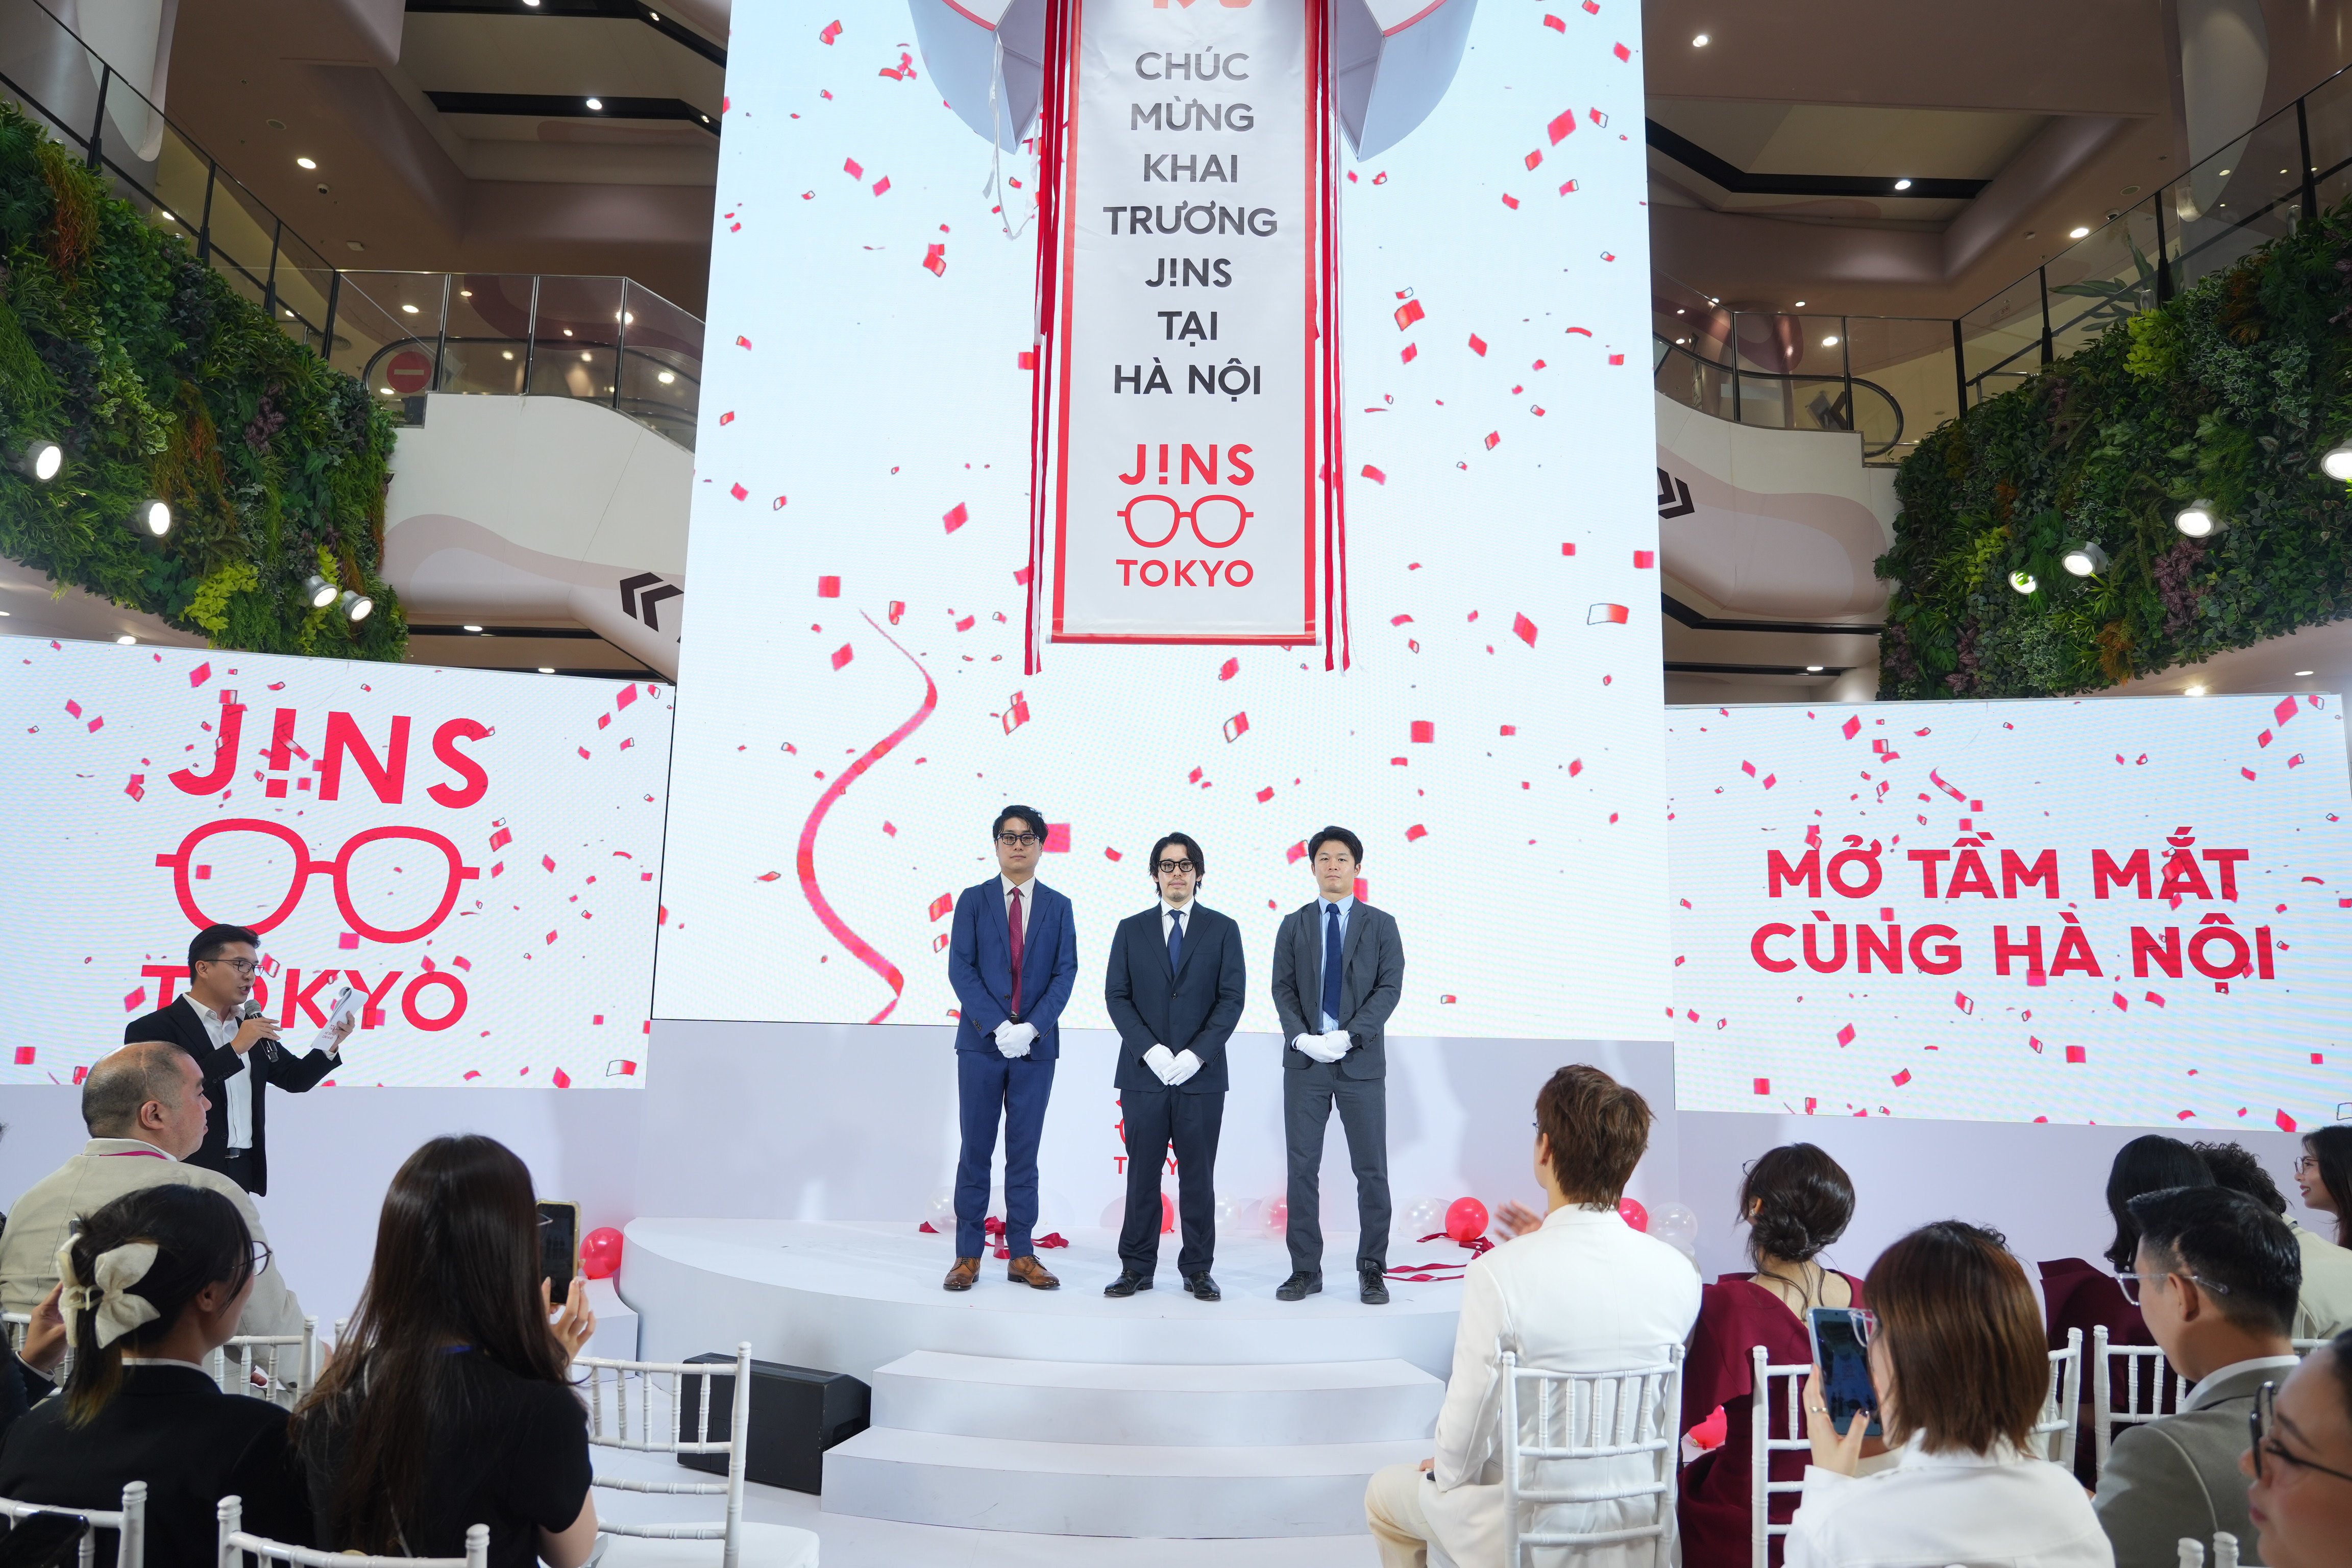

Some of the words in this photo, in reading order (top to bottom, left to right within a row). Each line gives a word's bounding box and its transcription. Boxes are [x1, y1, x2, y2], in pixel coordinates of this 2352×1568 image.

[1135, 46, 1250, 81] CHÚC
[1131, 96, 1254, 131] MỪNG
[1144, 154, 1237, 183] KHAI
[1103, 200, 1277, 237] TRƯƠNG
[1158, 311, 1217, 347] TẠI
[1114, 357, 1172, 395] HÀ
[1189, 358, 1260, 402] NỘI
[1116, 559, 1254, 587] TOKYO
[1767, 835, 1882, 898] MỞ
[1907, 831, 2060, 899] TẦM
[2092, 826, 2249, 900] MẮT
[1751, 910, 1962, 975] CÙNG
[1994, 912, 2103, 977] HÀ
[2130, 913, 2274, 993] NỘI
[141, 964, 468, 1032] TKYO
